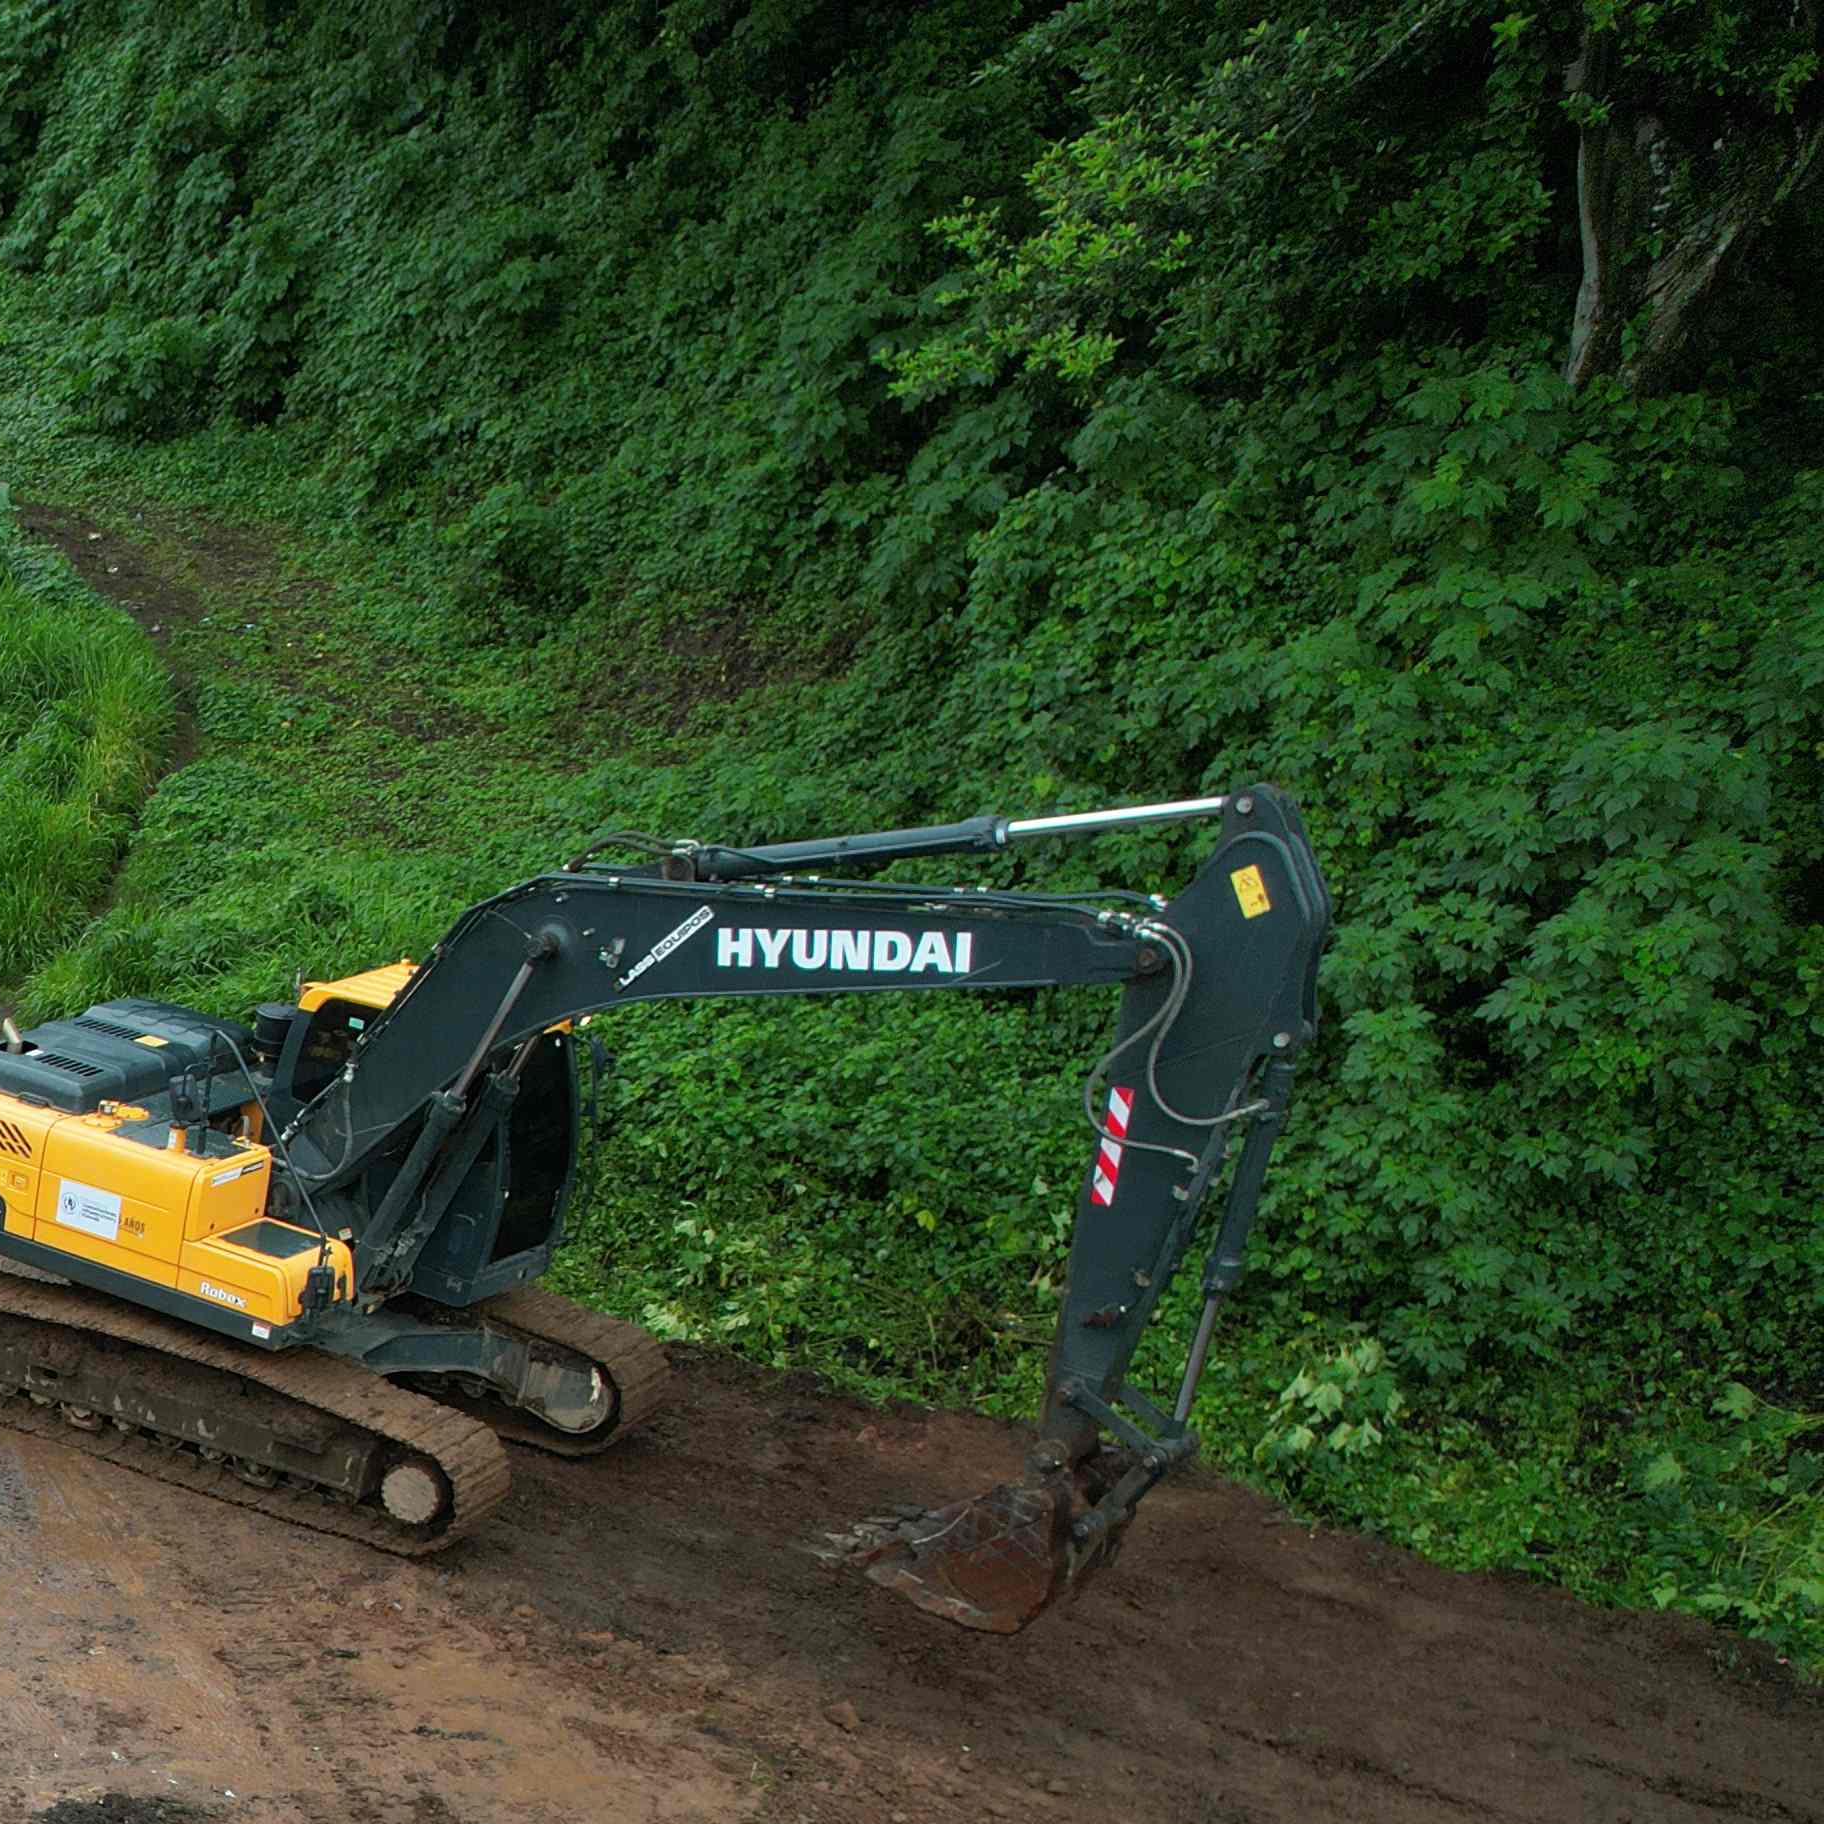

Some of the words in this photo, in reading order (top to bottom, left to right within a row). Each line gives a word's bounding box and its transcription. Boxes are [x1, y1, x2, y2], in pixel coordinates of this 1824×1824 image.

[654, 908, 711, 957] EQUIPOS
[717, 927, 973, 974] HYUNDAI
[200, 1281, 248, 1308] Robex
